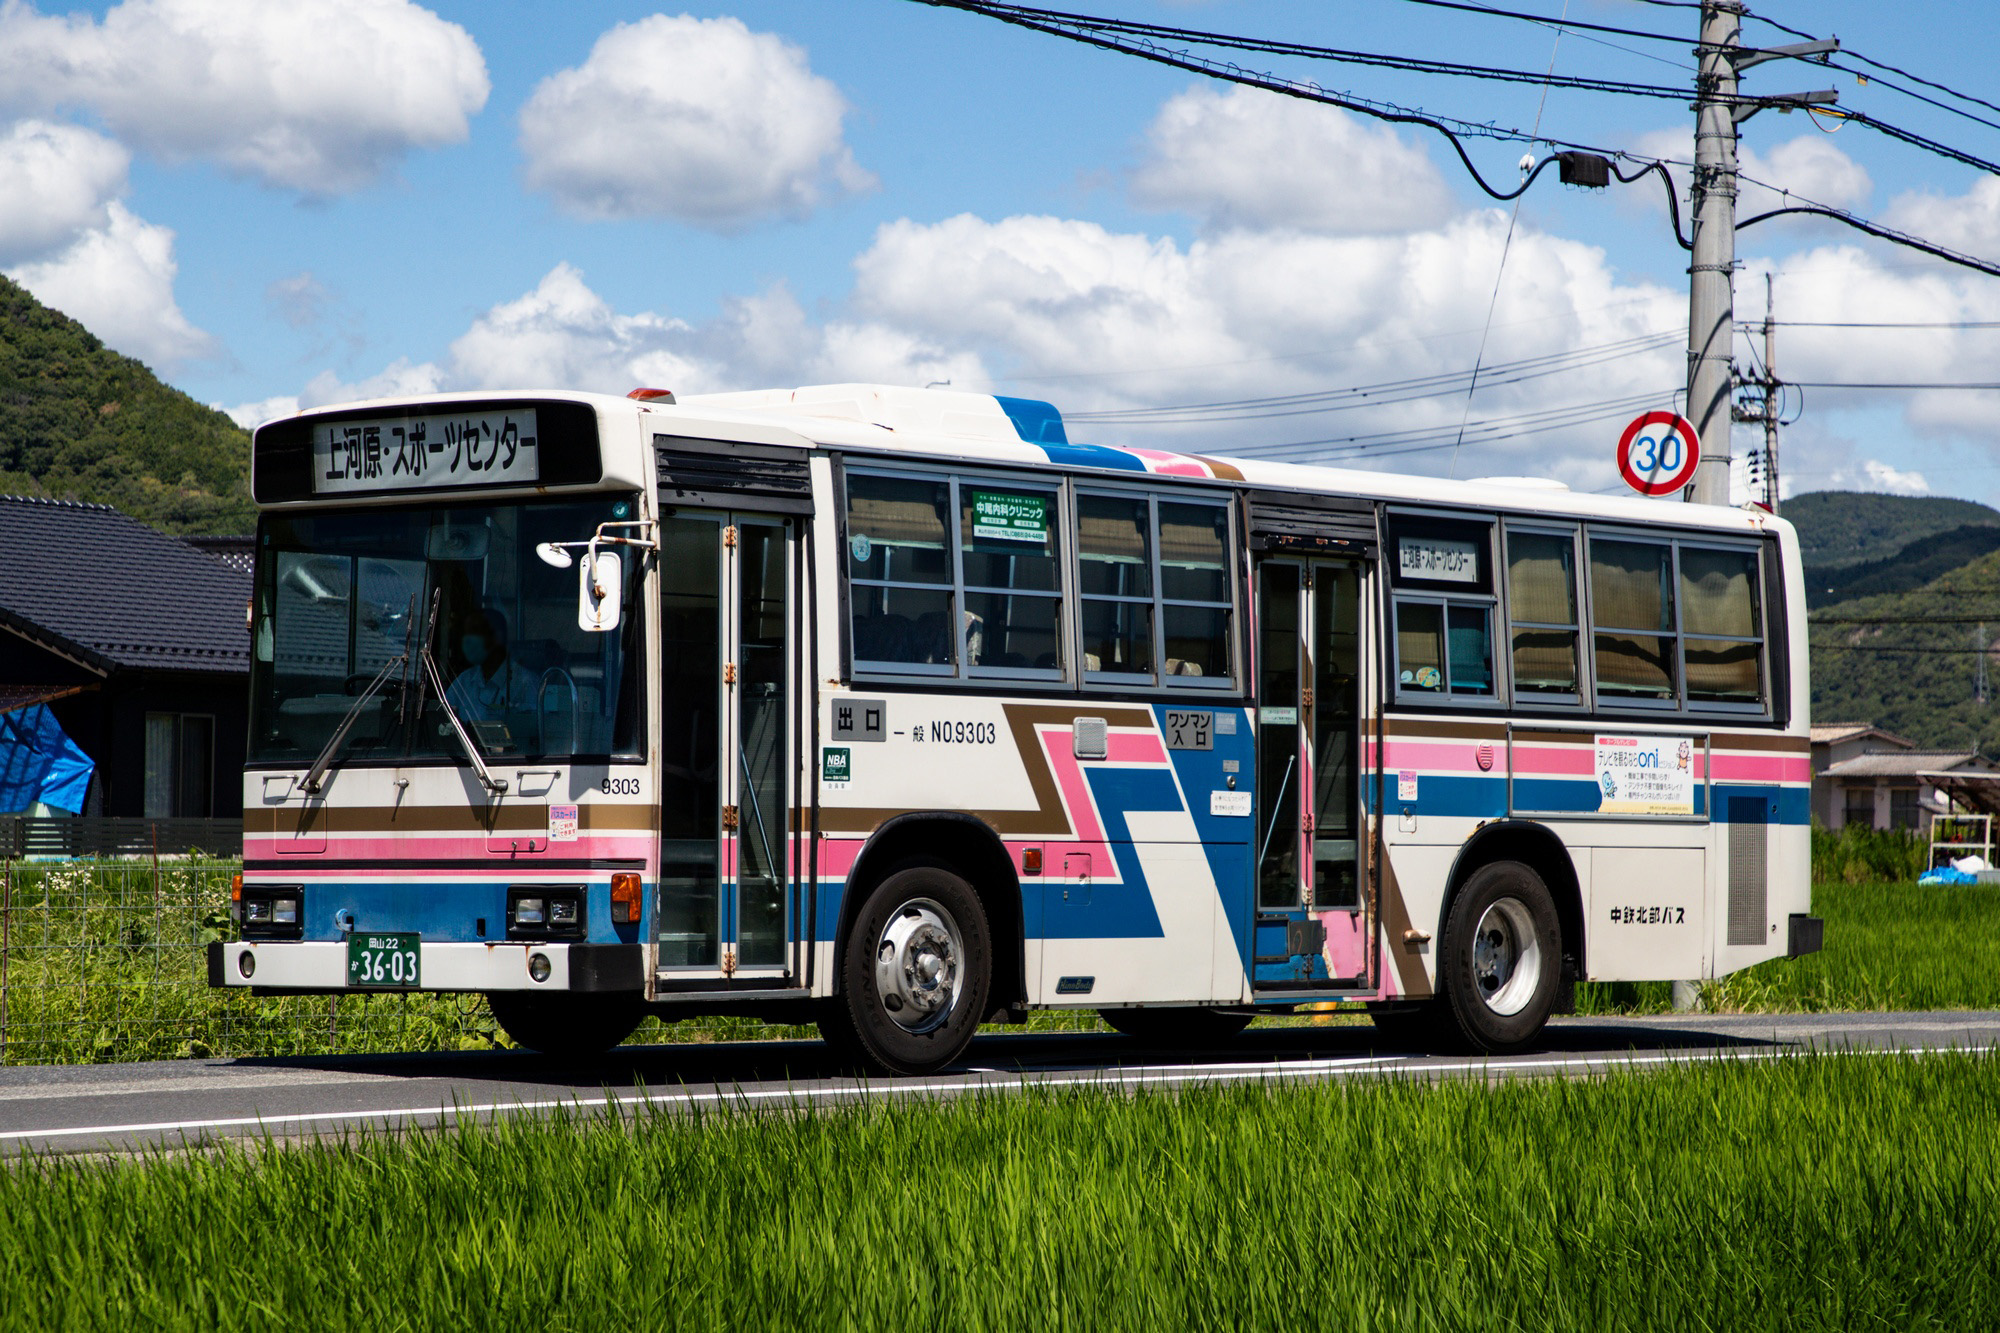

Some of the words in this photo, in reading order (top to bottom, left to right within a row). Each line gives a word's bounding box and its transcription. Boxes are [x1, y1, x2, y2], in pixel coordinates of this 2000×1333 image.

[326, 416, 536, 480] 上河原・スポーツセンター
[1636, 435, 1680, 472] 30
[976, 502, 1043, 519] 中尾内科クリニック
[1402, 544, 1468, 573] 上河原・スポーツセンター
[838, 707, 880, 732] 出口
[1168, 713, 1211, 729] ワンマン
[931, 720, 996, 744] NO.9303
[1173, 730, 1206, 746] 入口
[827, 754, 847, 766] NBA
[602, 778, 640, 795] 9303
[1611, 906, 1685, 924] 中鉄北部バス
[369, 938, 385, 949] 岡山
[385, 938, 399, 949] 22
[351, 960, 359, 971] か
[360, 951, 417, 981] 36-03
